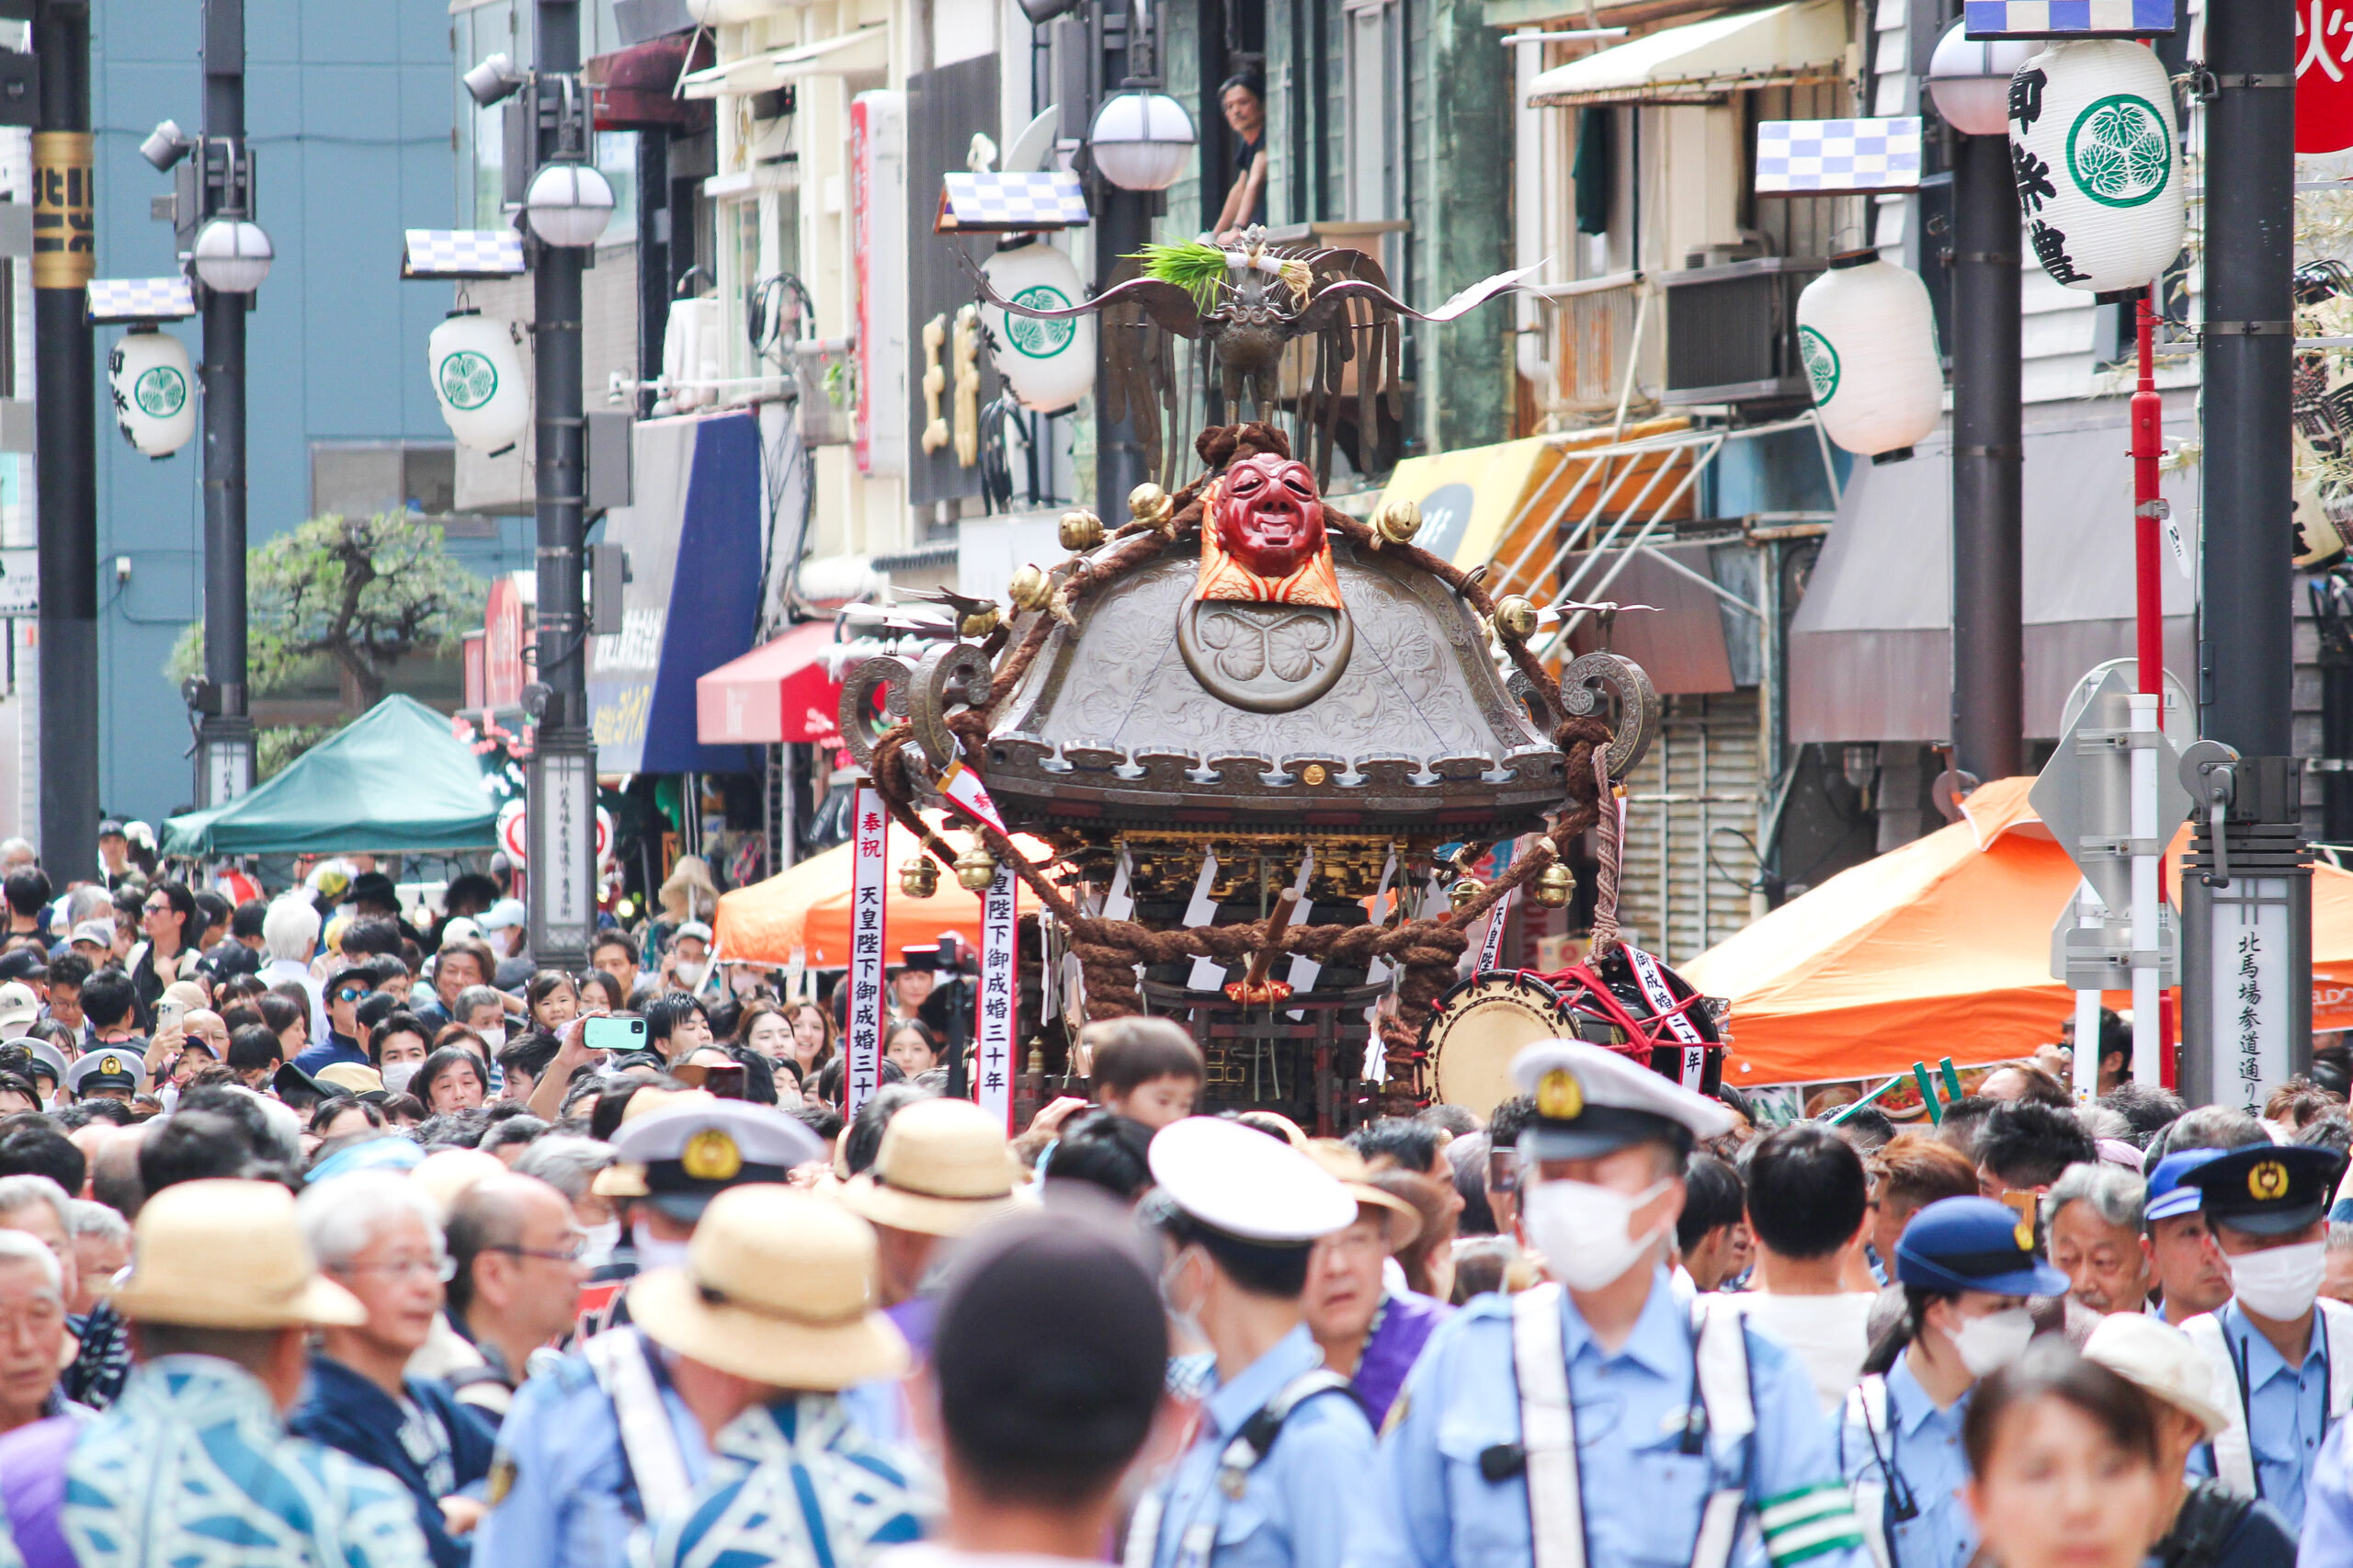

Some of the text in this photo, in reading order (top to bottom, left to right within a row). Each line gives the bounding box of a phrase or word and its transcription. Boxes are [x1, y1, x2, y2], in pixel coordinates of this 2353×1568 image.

[860, 811, 882, 858] 奉祝
[983, 872, 1011, 1094] 皇陛下御成婚三十年
